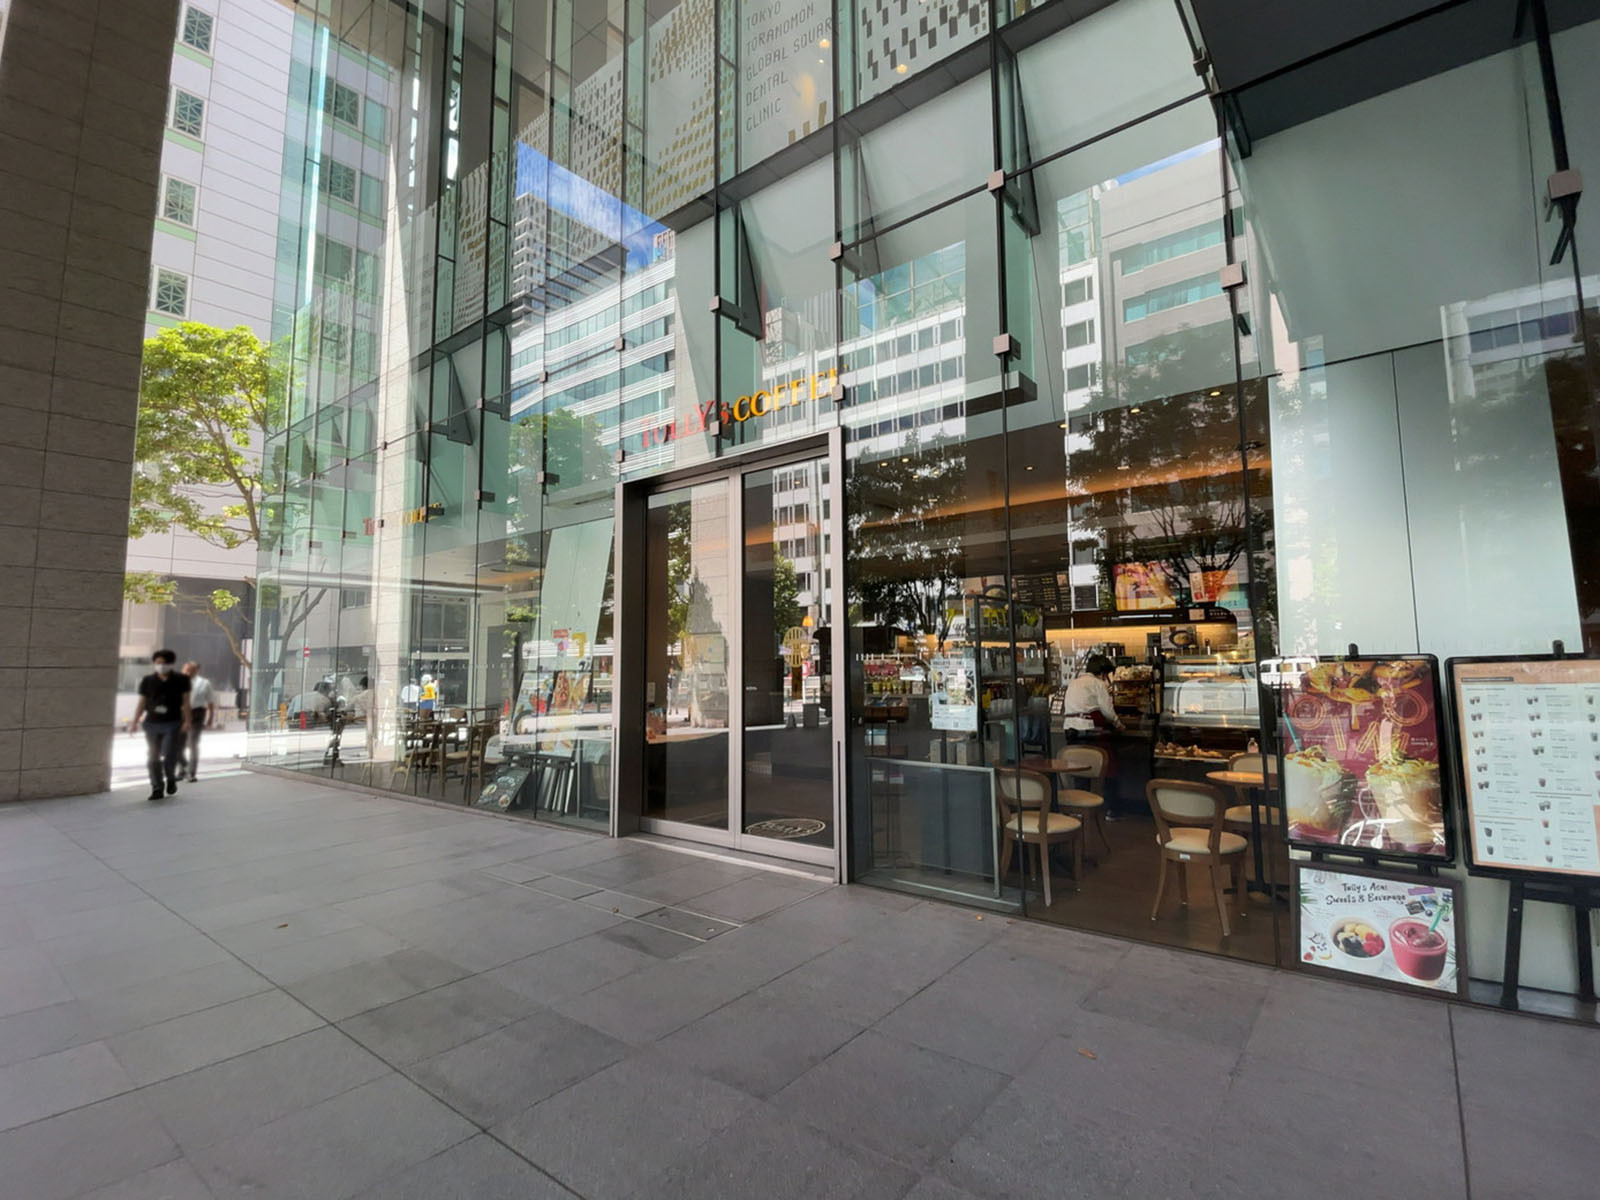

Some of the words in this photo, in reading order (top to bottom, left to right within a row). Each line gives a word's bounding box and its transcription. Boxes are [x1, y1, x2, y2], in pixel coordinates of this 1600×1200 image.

[747, 1, 781, 31] TOKYO
[747, 3, 815, 56] TORANOMON
[746, 46, 789, 82] GLOBAL
[746, 71, 789, 107] DENTAL
[746, 97, 782, 132] CLINIC
[640, 400, 730, 449] TULLYS
[1325, 894, 1357, 905] Sweets
[1358, 894, 1365, 903] &
